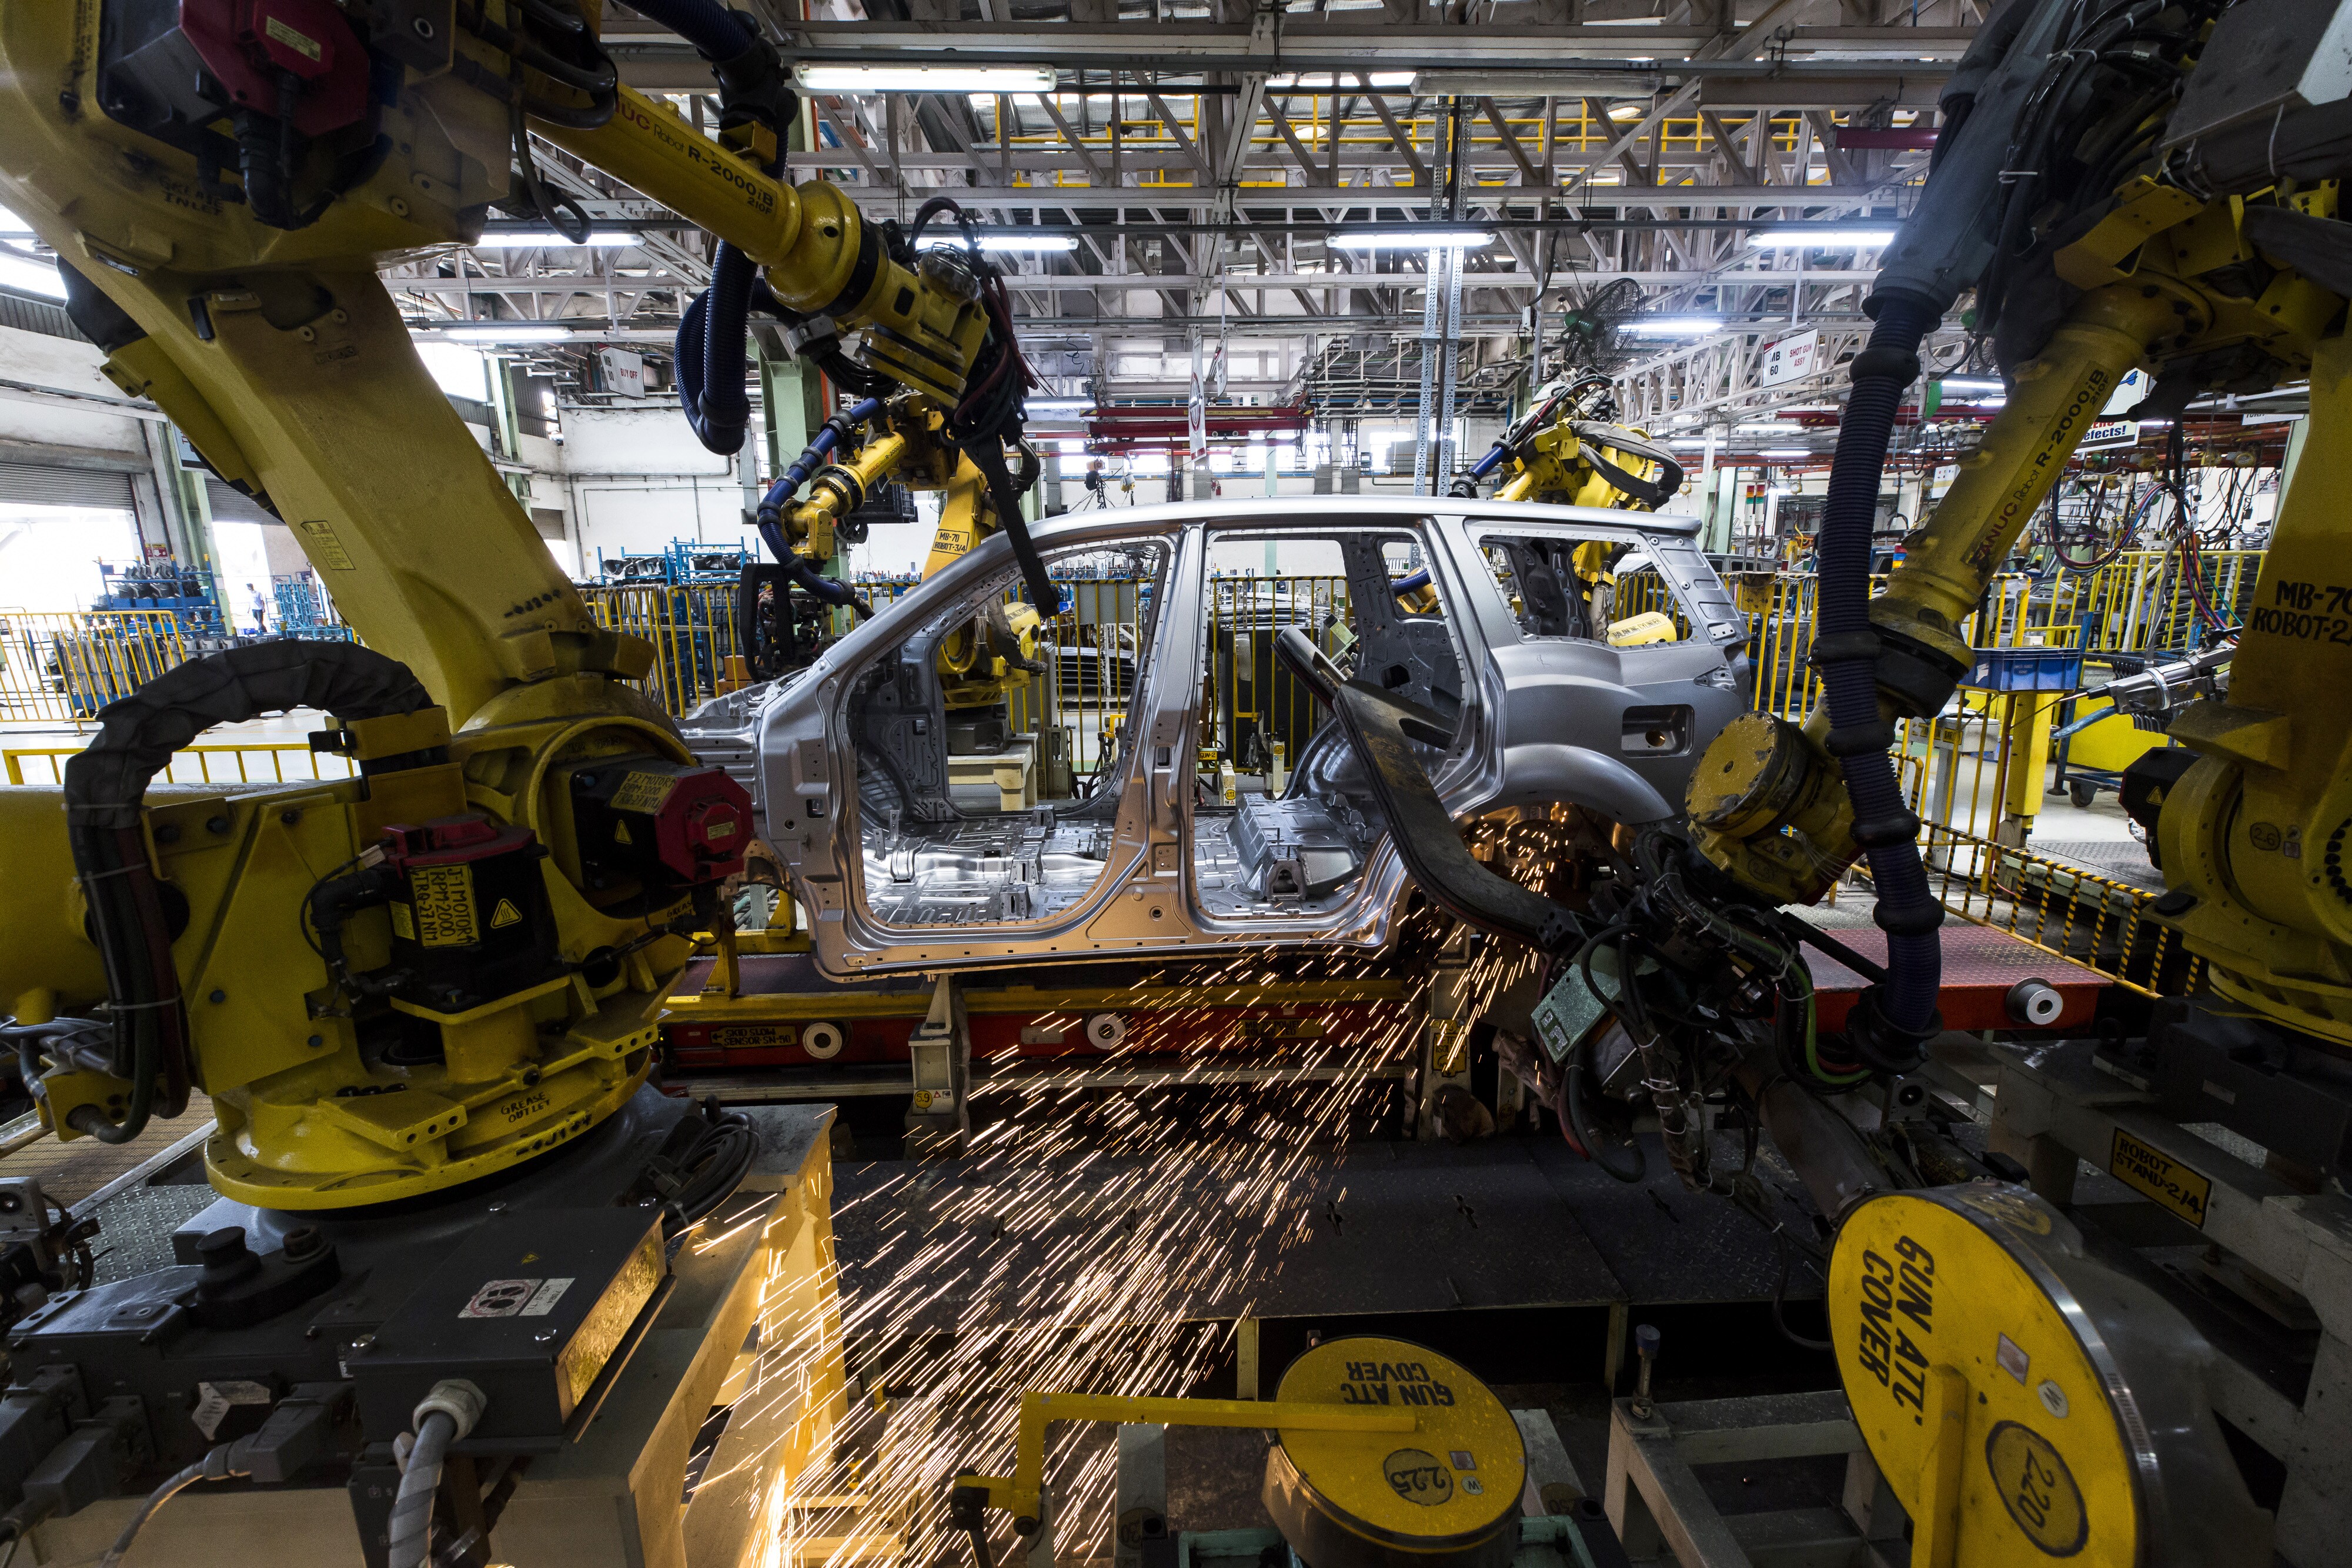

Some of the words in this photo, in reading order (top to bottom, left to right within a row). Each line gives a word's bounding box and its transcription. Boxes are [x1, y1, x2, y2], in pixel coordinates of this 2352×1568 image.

[654, 123, 685, 153] Robot
[688, 145, 773, 206] R-2000iB
[747, 197, 773, 215] 210F
[1770, 351, 1780, 362] MB
[1789, 346, 1802, 357] SHOT
[1803, 343, 1812, 353] GUN
[1794, 356, 1805, 367] ASSY
[620, 368, 629, 378] BUY
[1770, 365, 1778, 376] 60
[2090, 375, 2111, 406] 210F
[2013, 470, 2040, 500] Robot
[2035, 369, 2104, 468] R-2000iB
[2083, 424, 2127, 441] efects!
[867, 462, 880, 476] FANUC
[934, 541, 966, 553] ROBOT-3/4
[940, 532, 960, 542] MB-70
[2251, 607, 2352, 646] ROBOT-2
[415, 872, 435, 918] TRQ-27
[430, 872, 456, 937] RPM-2000
[451, 890, 472, 937] MOTOR
[422, 921, 438, 941] NM
[725, 1028, 748, 1038] SKID
[749, 1028, 776, 1036] SLOW
[501, 1091, 546, 1115] GREASE
[916, 1093, 930, 1102] 5.9
[509, 1099, 550, 1123] OUTLET
[2119, 1138, 2173, 1175] ROBOT
[1895, 1235, 1935, 1334] GUN
[1859, 1249, 1894, 1388] COVER
[1345, 1361, 1431, 1382] COVER
[1340, 1382, 1389, 1406] ATC
[1398, 1380, 1455, 1406] GUN
[1390, 1466, 1446, 1495] 2.25
